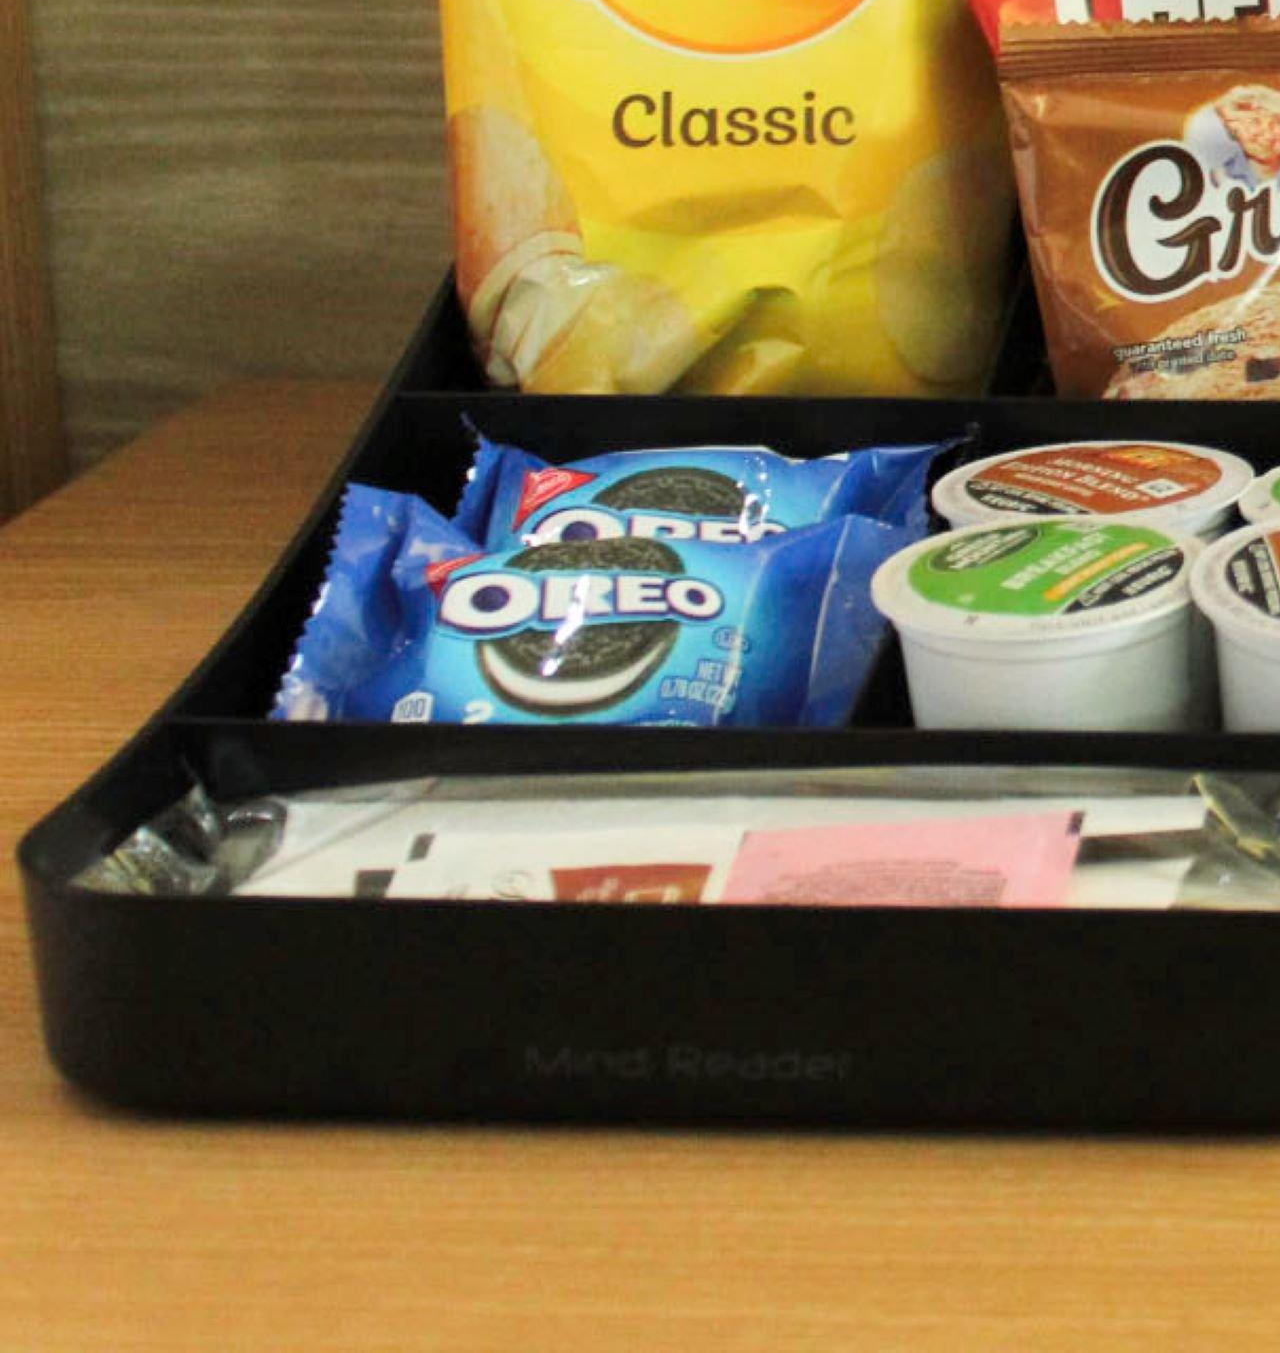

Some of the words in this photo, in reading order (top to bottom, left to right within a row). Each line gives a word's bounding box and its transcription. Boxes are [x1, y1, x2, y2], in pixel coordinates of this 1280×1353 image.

[611, 90, 857, 148] Classic
[1112, 329, 1203, 363] guaranteed
[1207, 326, 1247, 345] fresh
[439, 572, 723, 630] OREO
[665, 1045, 853, 1082] Reader
